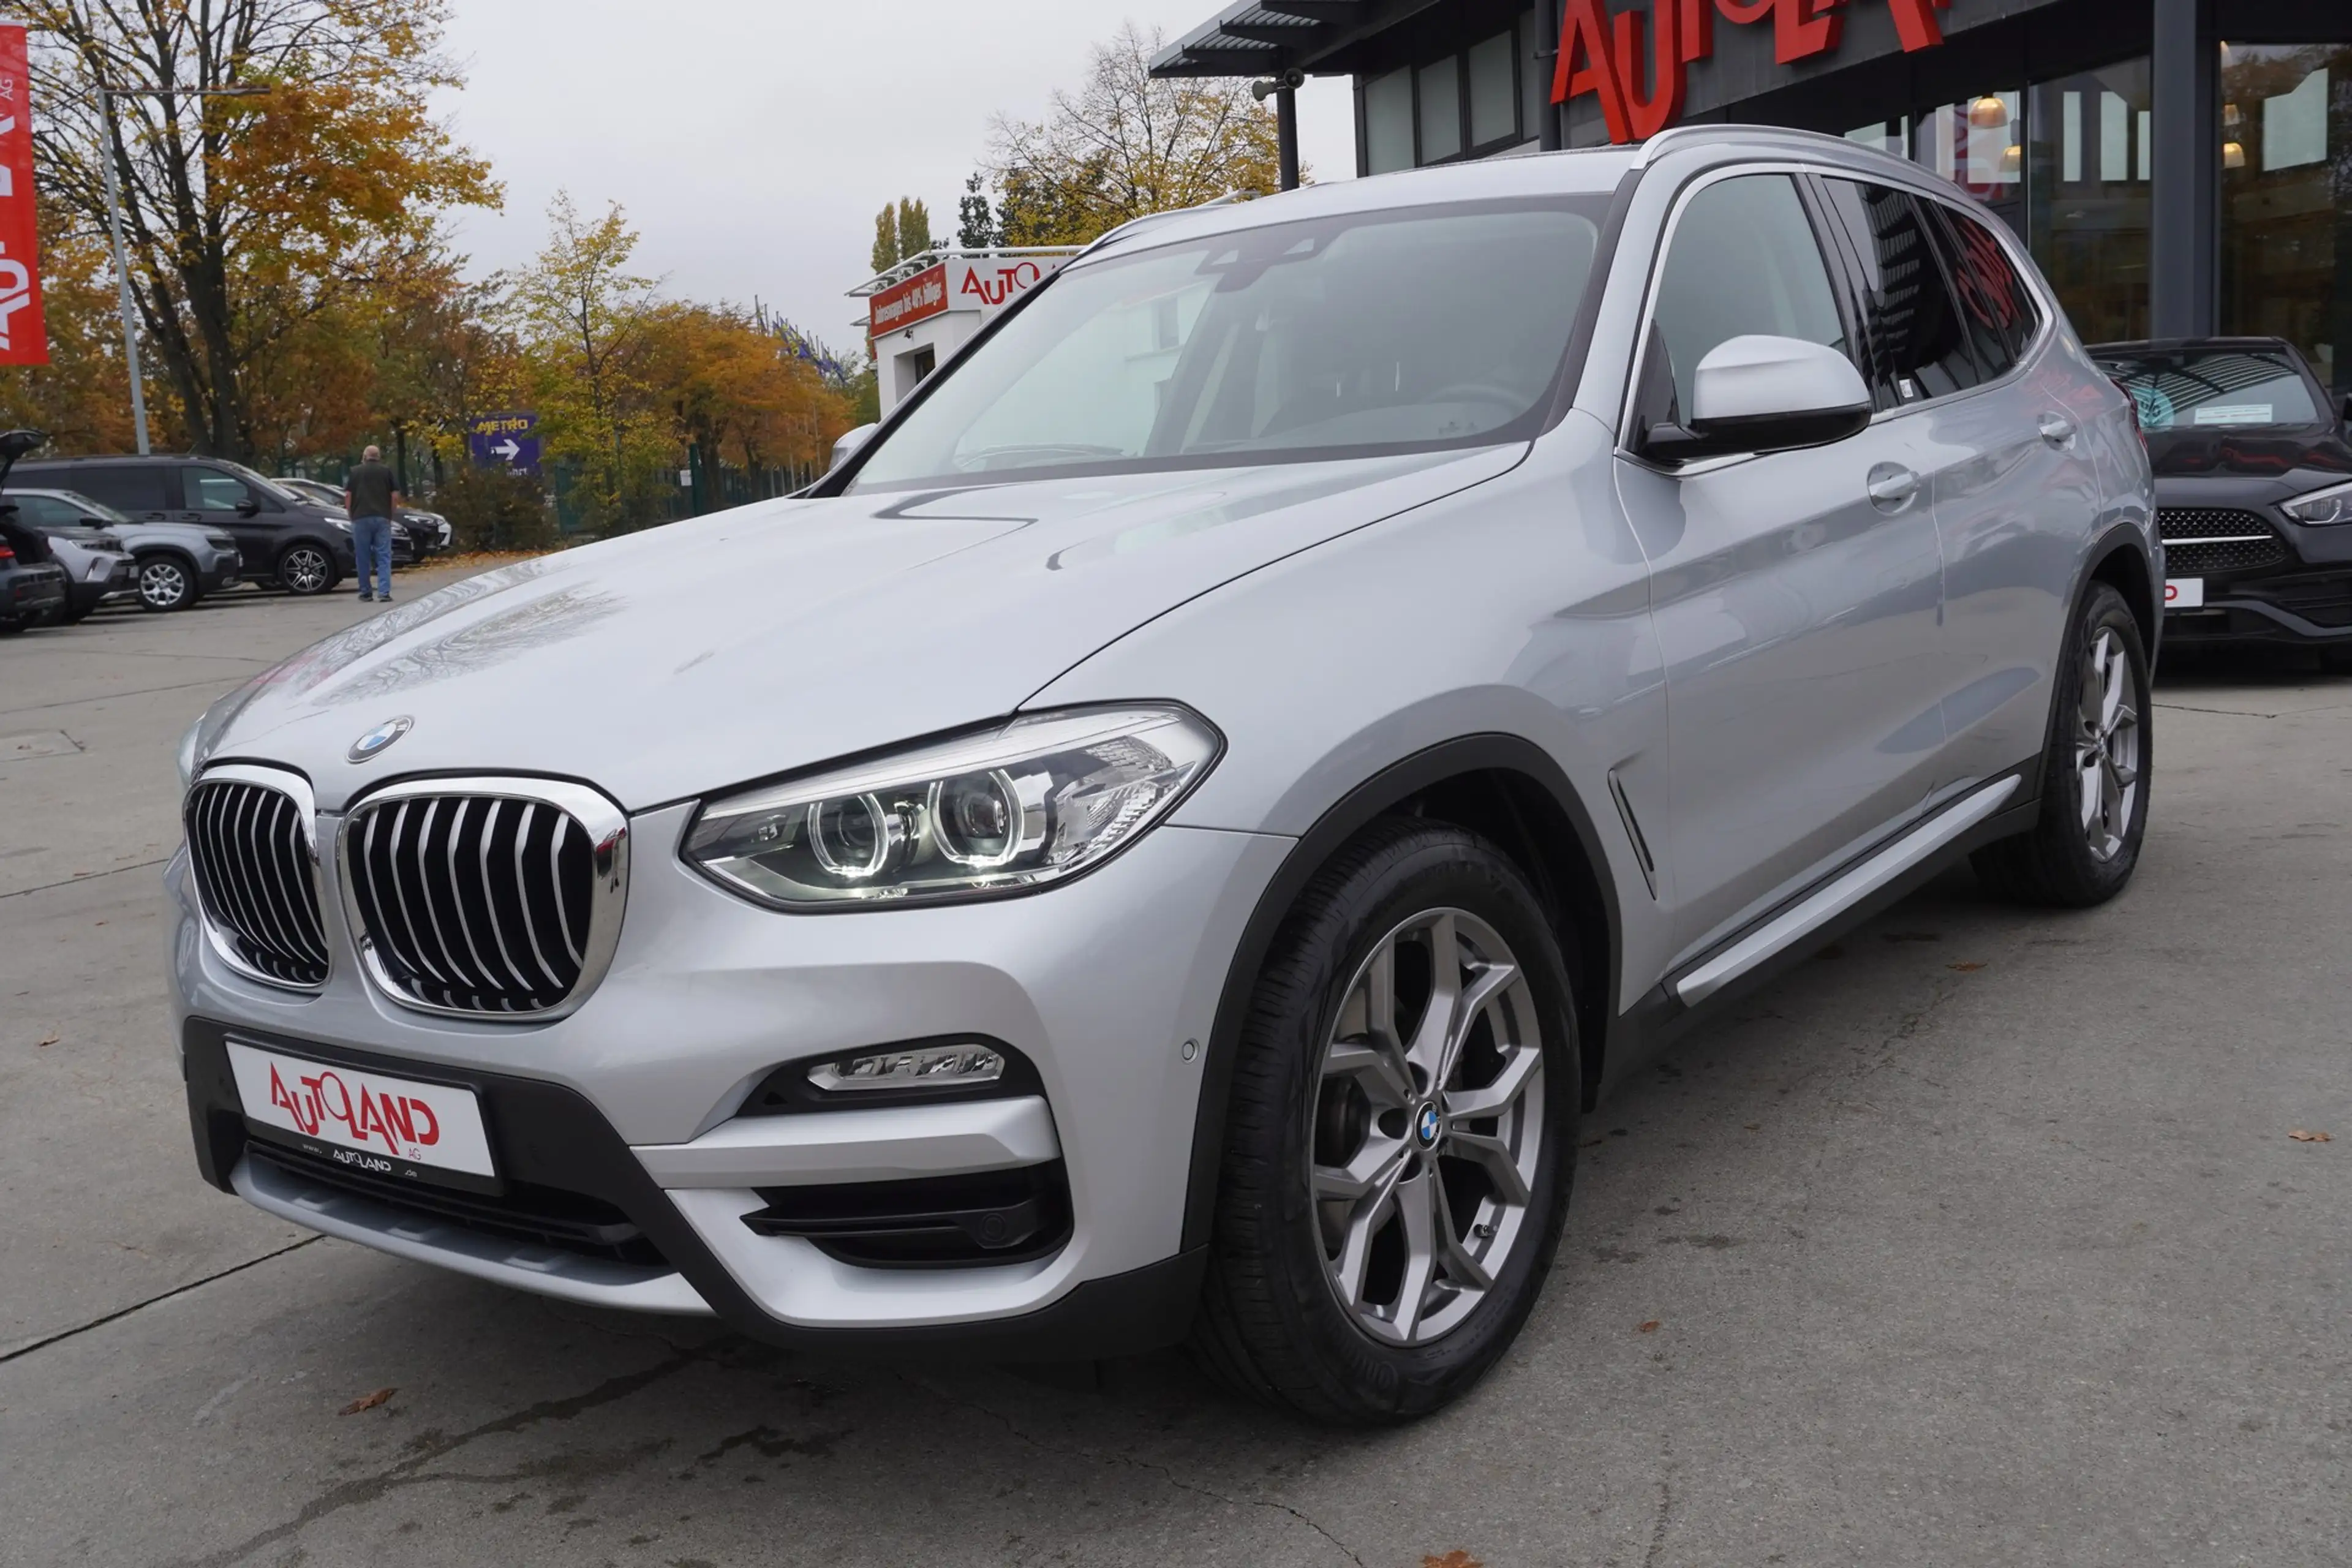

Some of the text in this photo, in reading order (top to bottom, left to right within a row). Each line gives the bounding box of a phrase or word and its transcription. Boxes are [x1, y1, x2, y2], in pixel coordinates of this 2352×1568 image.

[270, 1061, 439, 1156] AUTOLAND
[333, 1149, 391, 1171] AUTOLAND
[409, 1148, 421, 1161] AG
